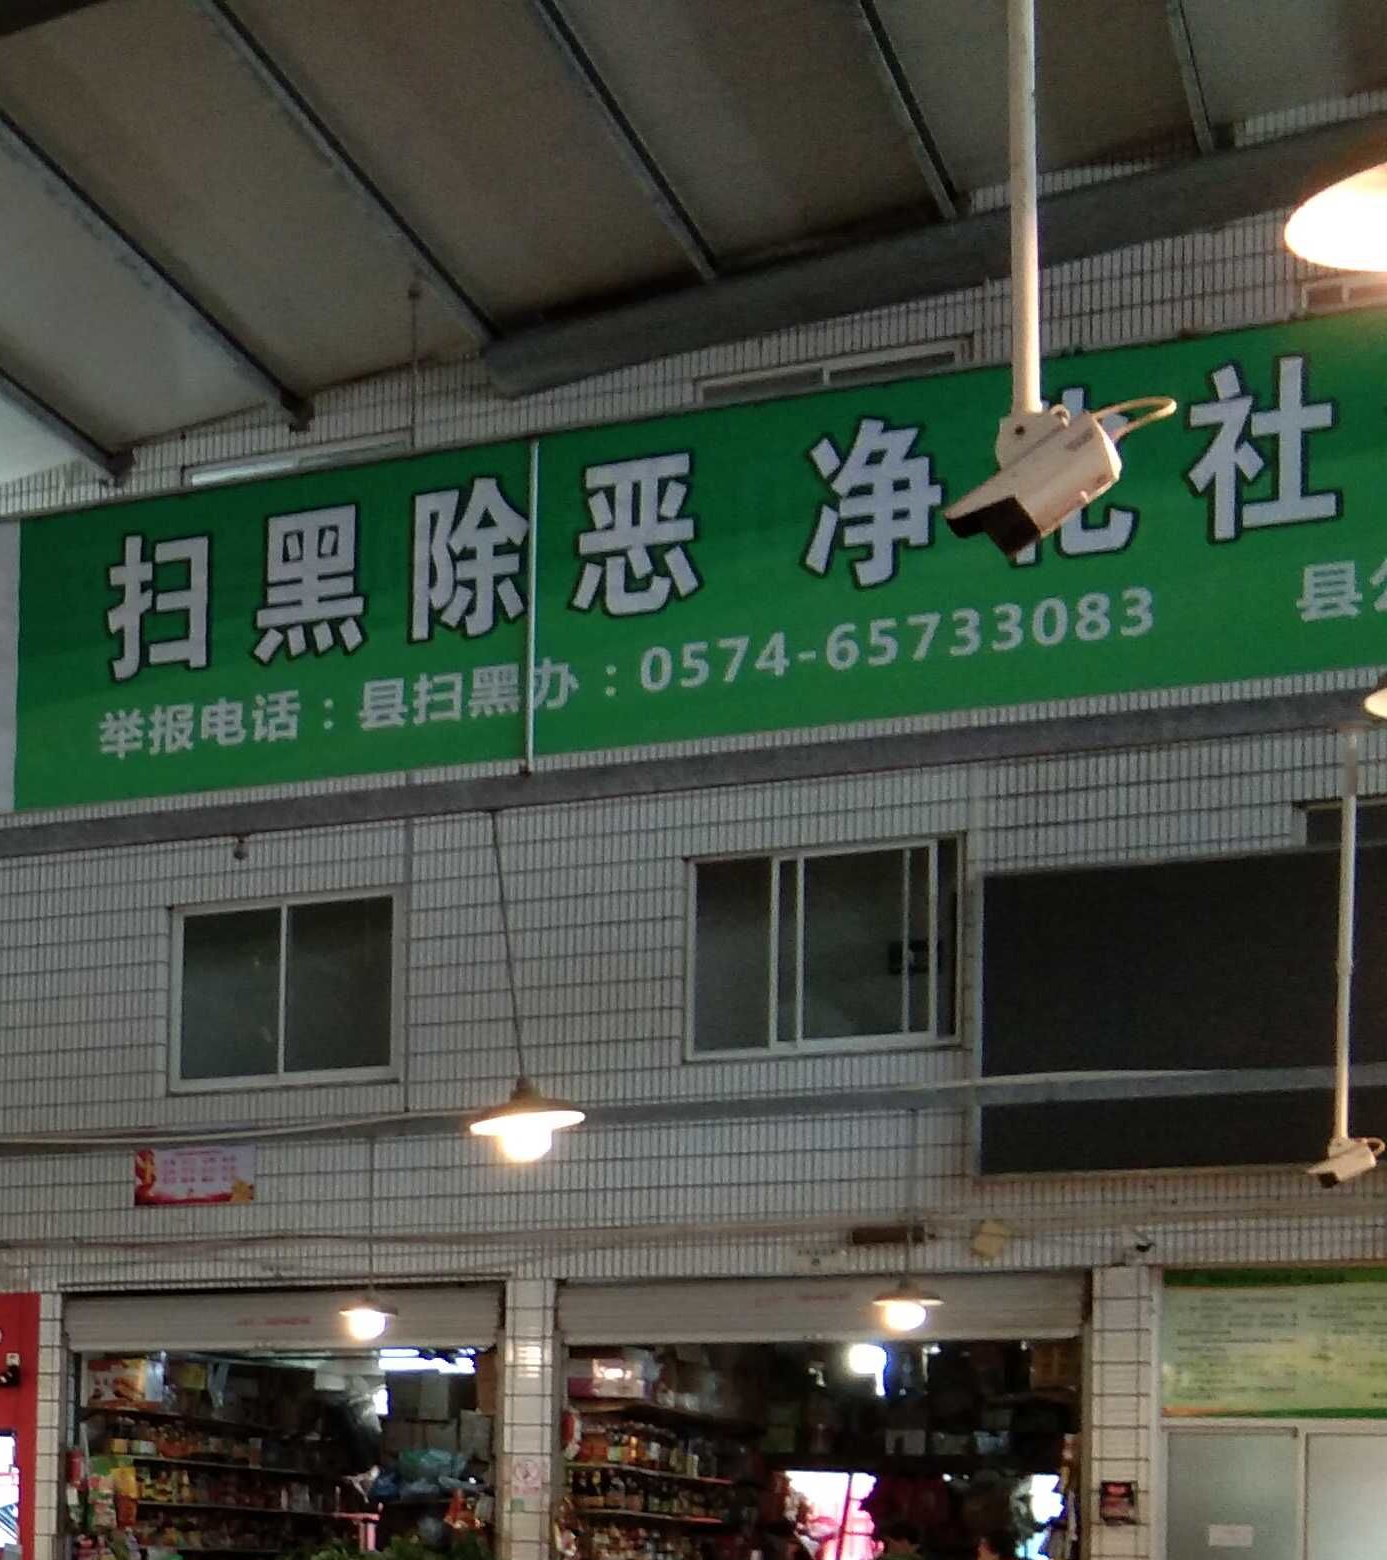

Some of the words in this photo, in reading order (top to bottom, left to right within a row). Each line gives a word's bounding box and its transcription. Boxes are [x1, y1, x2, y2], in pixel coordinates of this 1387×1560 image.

[106, 451, 700, 681] 扫黑除恶
[1296, 558, 1387, 622] 县
